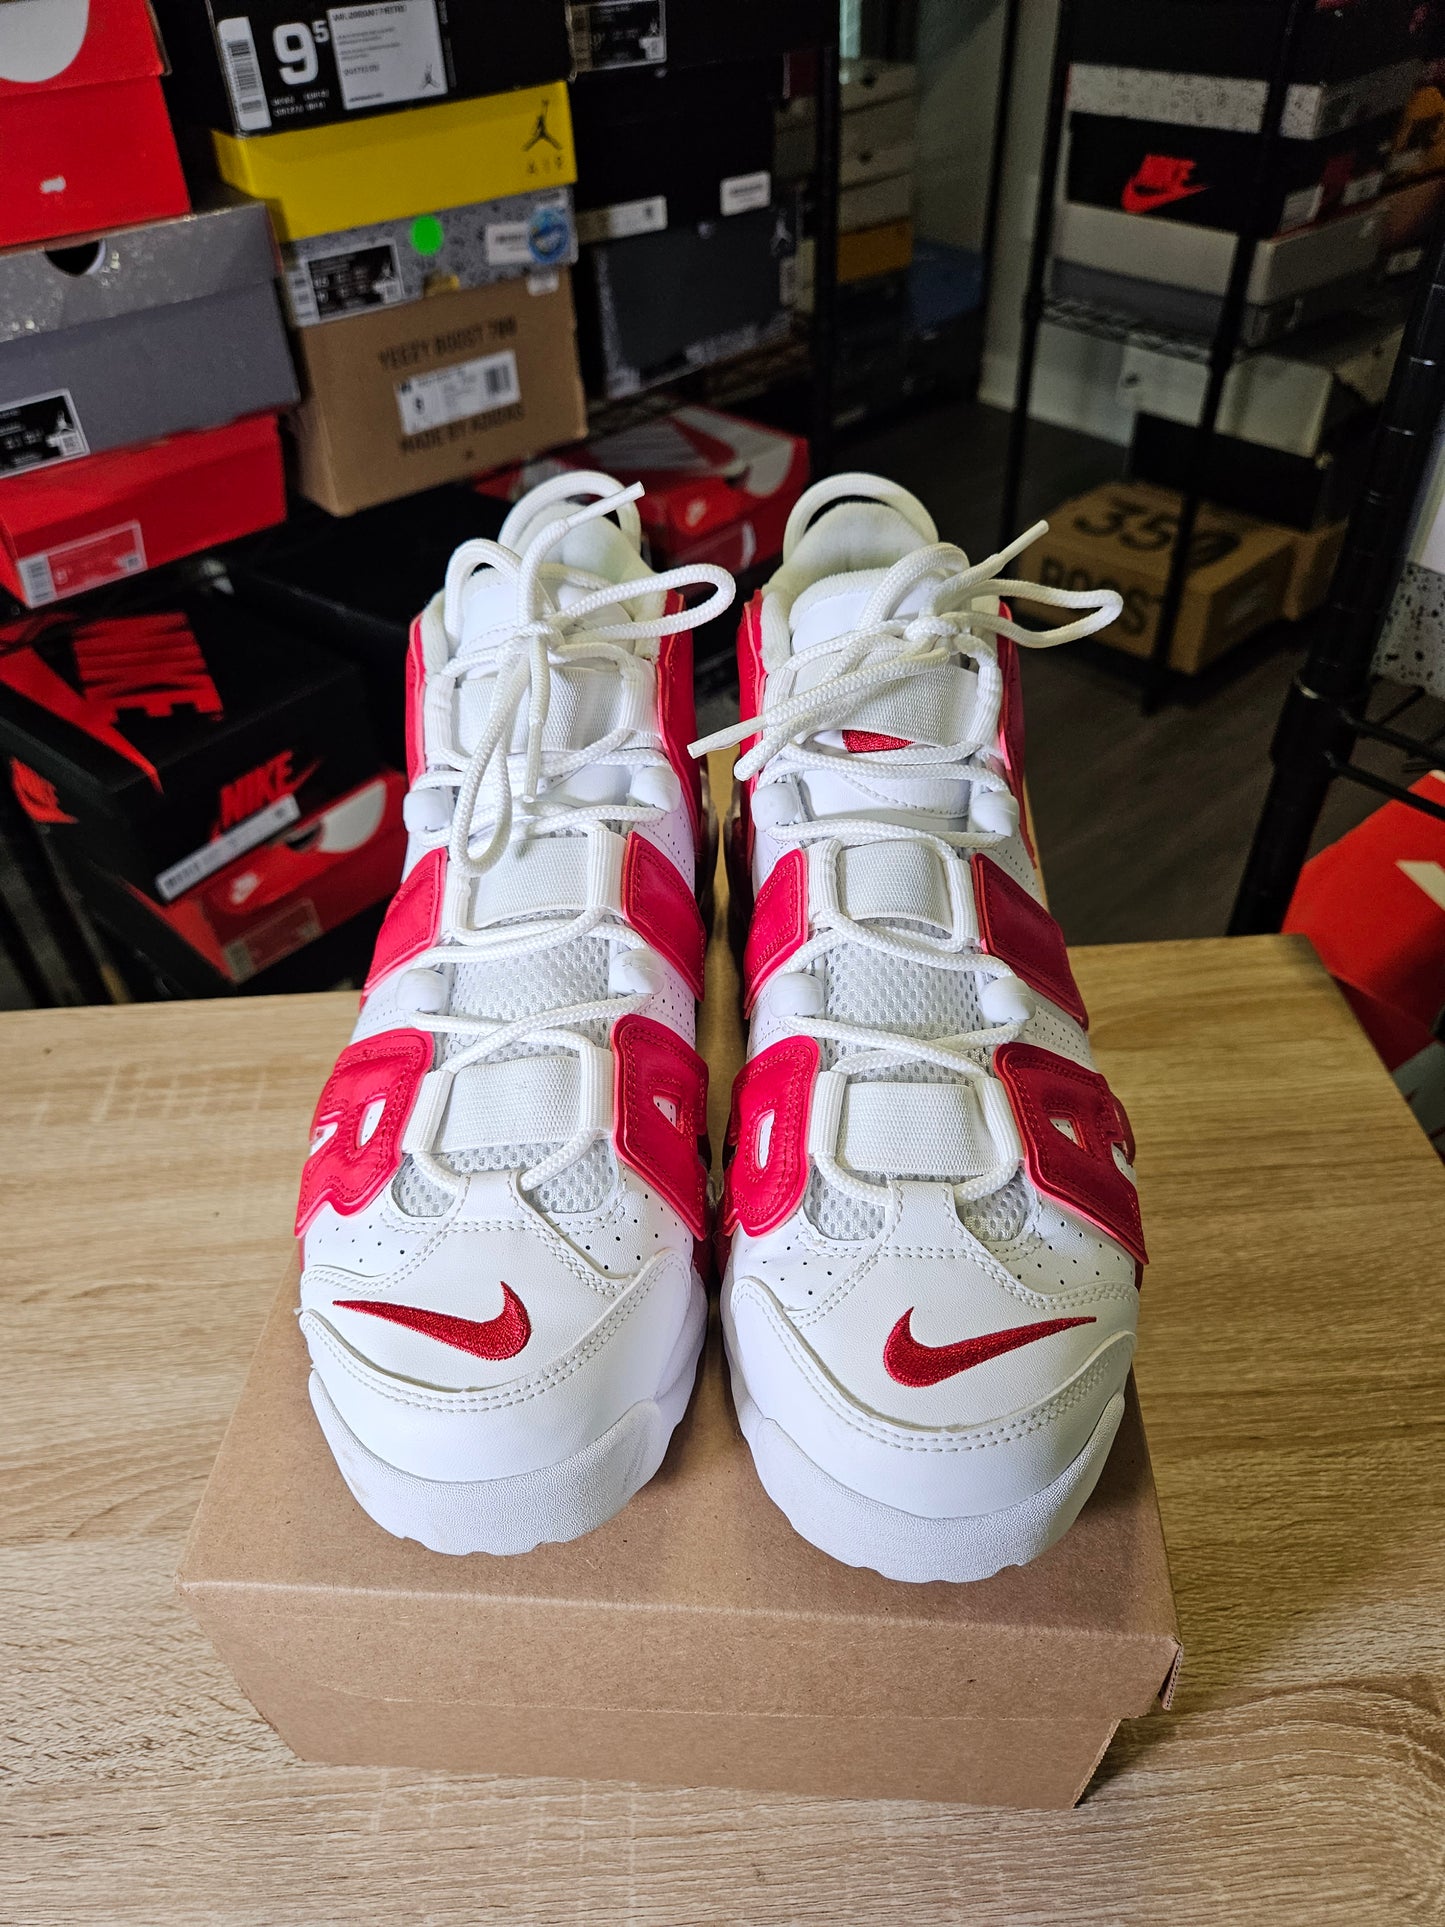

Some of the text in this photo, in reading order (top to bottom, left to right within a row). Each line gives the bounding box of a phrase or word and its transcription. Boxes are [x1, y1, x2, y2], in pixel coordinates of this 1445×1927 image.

[273, 22, 319, 85] 9
[1041, 553, 1166, 636] BOS
[219, 750, 293, 829] NIKE
